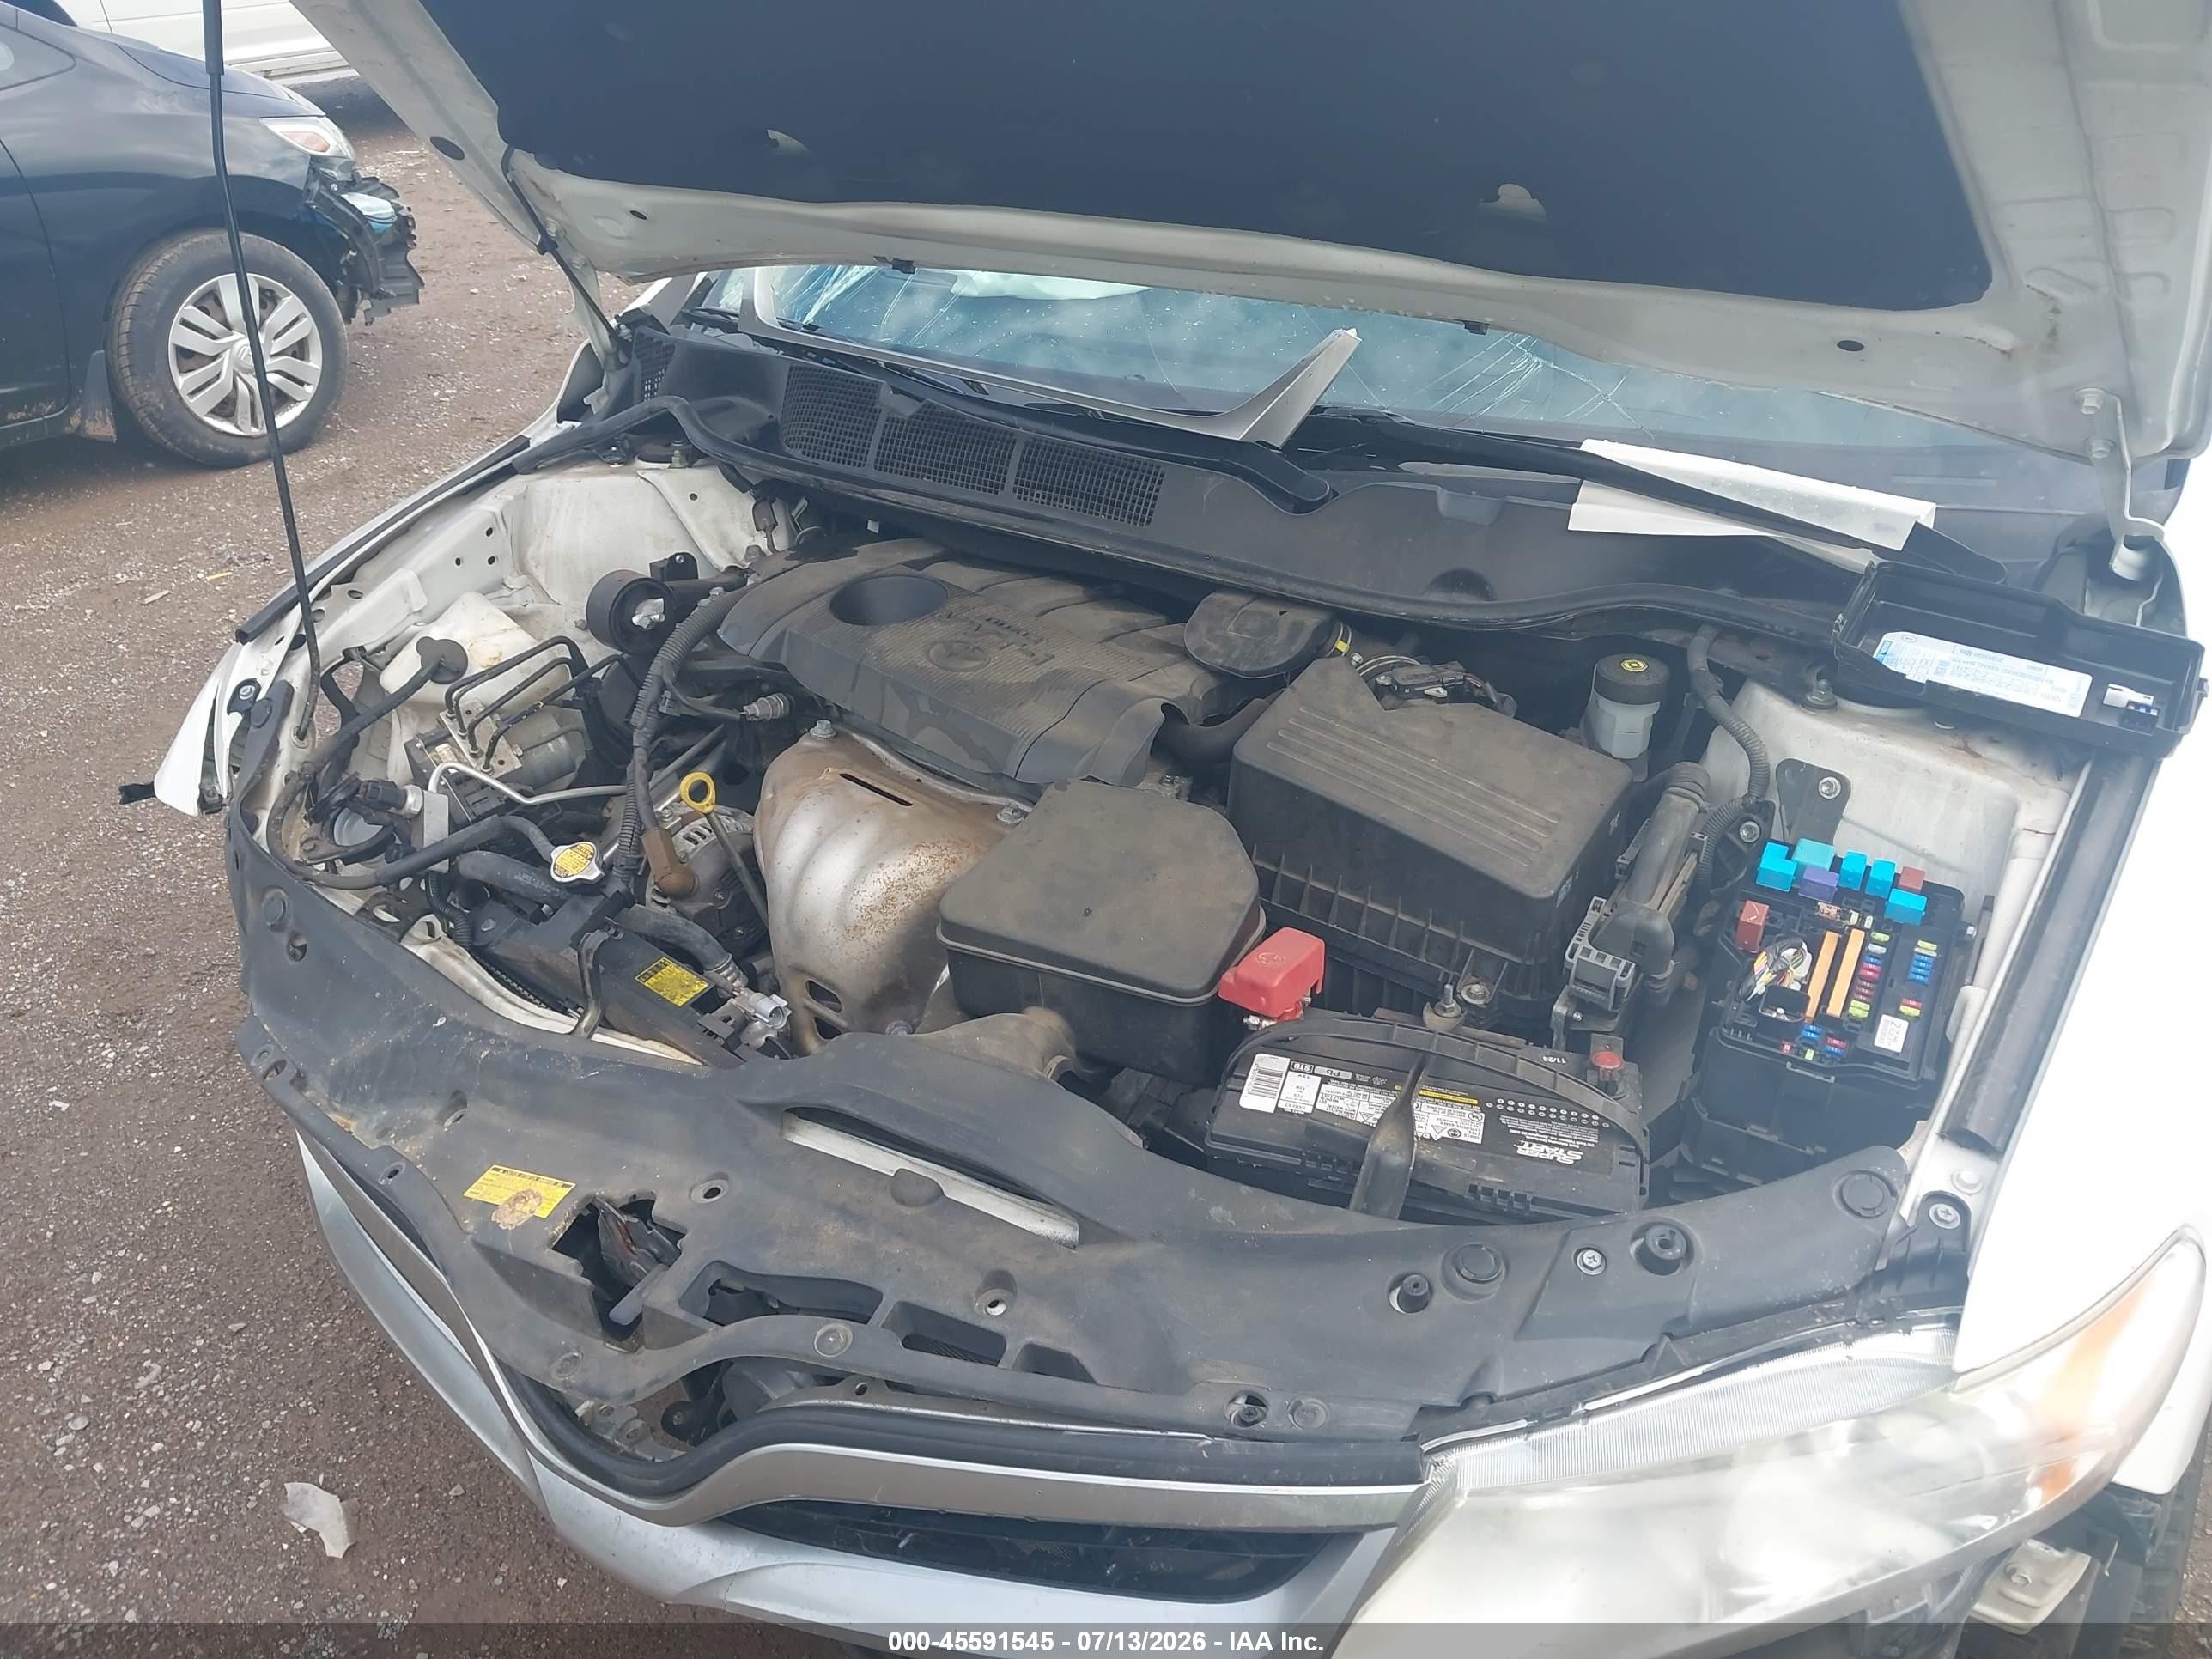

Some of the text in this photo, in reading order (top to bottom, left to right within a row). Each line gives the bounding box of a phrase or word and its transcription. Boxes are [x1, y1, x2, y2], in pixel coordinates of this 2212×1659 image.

[1542, 1055, 1567, 1064] 11/24
[1326, 1068, 1341, 1078] Pb
[1516, 1147, 1575, 1164] SUPER
[1518, 1140, 1584, 1160] START
